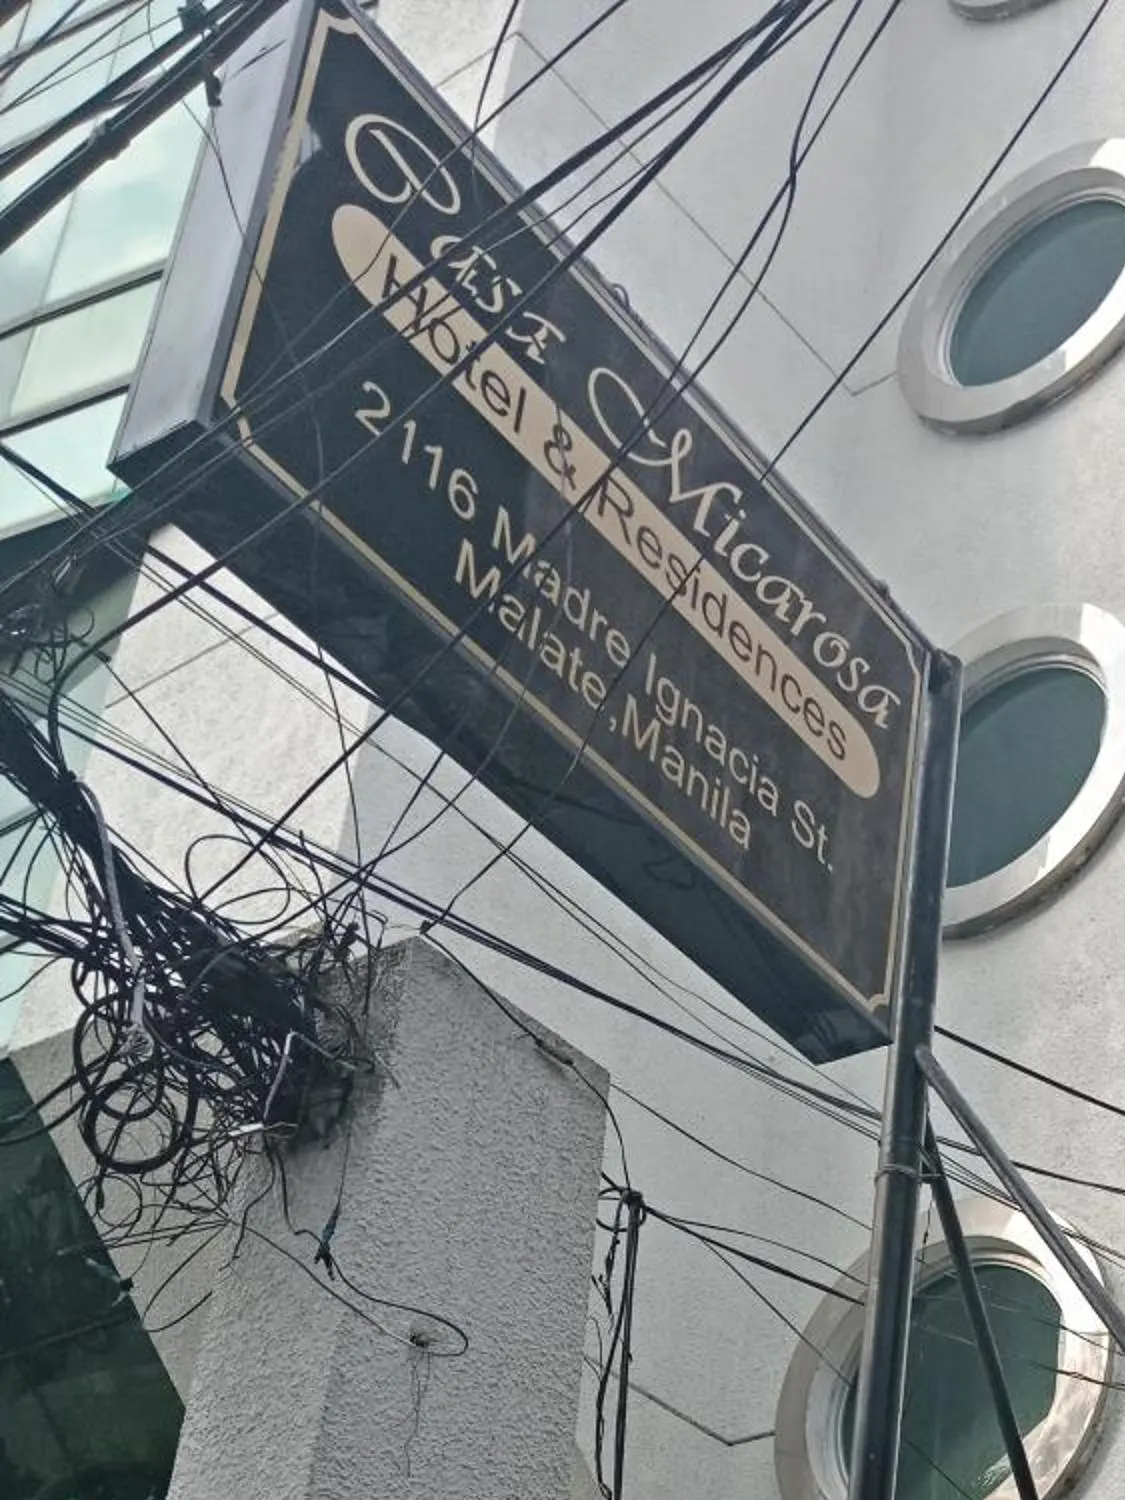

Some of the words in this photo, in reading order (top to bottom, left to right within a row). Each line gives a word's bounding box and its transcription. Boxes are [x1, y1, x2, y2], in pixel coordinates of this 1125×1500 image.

[354, 381, 479, 520] 2116
[492, 505, 631, 668] Madre
[645, 653, 779, 816] Ignacia
[791, 800, 833, 872] St.
[382, 254, 527, 433] Hotel
[544, 424, 577, 490] &
[597, 475, 847, 761] Residences
